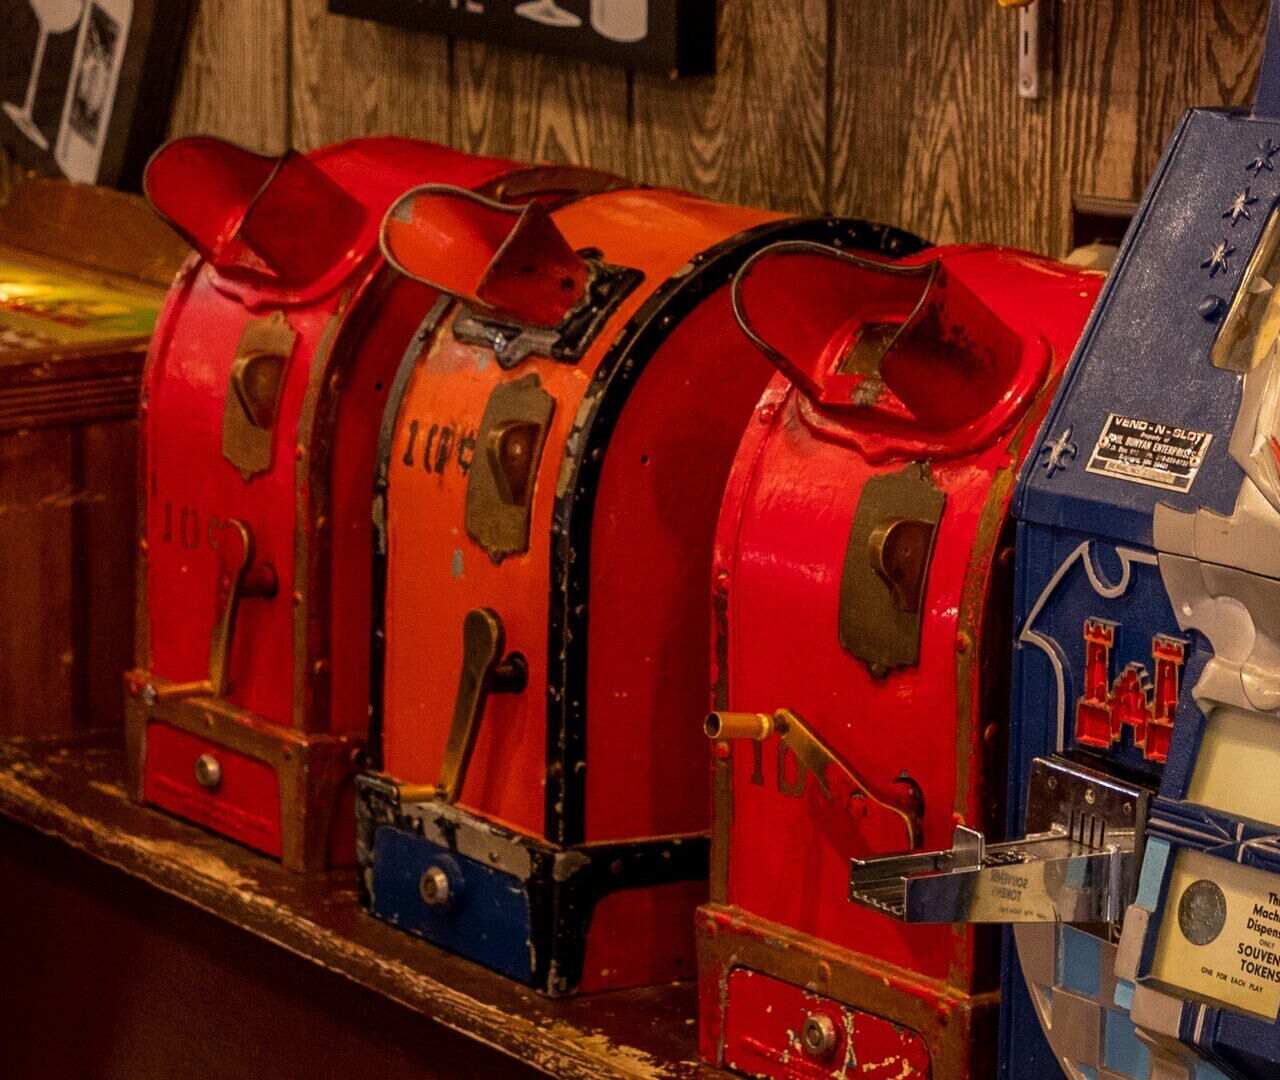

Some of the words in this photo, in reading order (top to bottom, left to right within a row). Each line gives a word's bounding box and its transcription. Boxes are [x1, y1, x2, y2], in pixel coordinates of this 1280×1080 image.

[1125, 436, 1152, 450] BUNYAN
[1259, 939, 1276, 949] ONLY
[1201, 966, 1214, 976] ONE
[1216, 971, 1228, 981] FOR
[1230, 976, 1247, 988] EACH
[1249, 982, 1264, 994] PLAY
